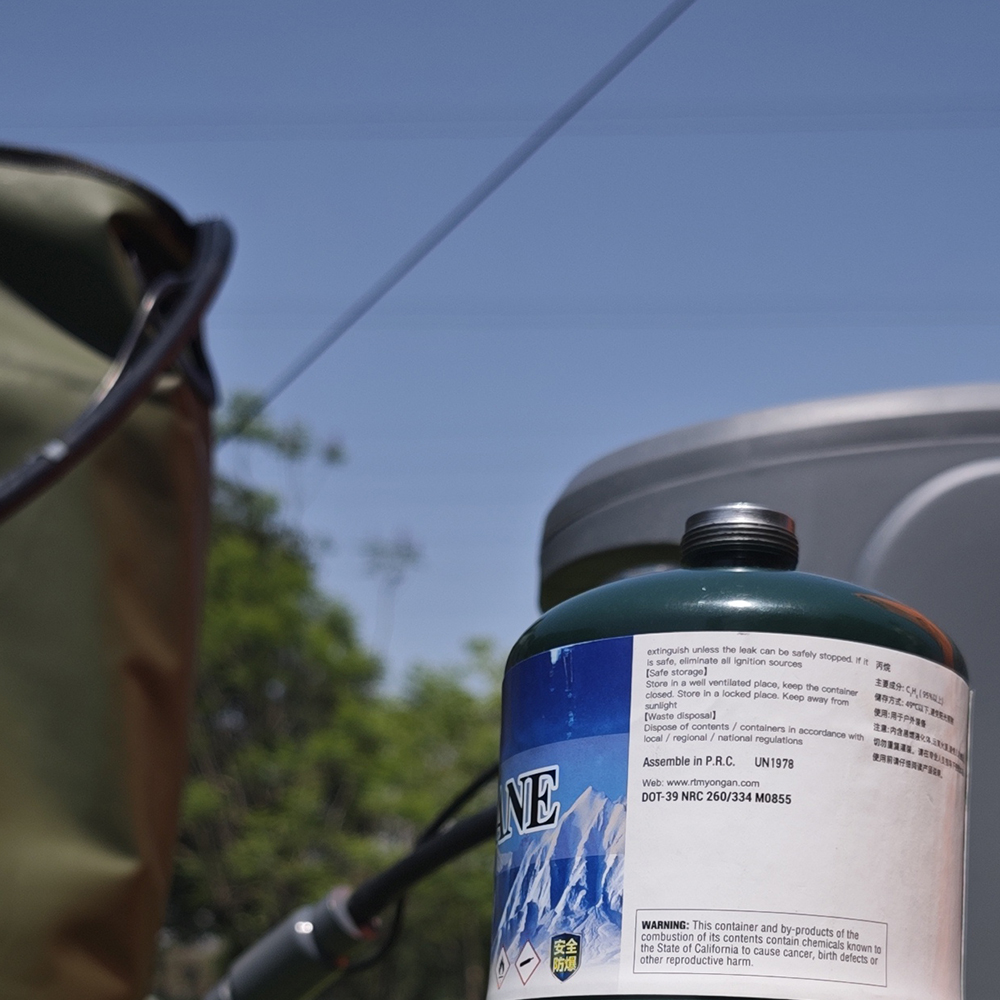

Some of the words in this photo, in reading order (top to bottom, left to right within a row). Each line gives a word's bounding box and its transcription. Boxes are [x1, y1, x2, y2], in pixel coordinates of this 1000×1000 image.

[647, 646, 689, 656] extinguish
[740, 646, 757, 654] leak
[792, 650, 817, 659] safely
[820, 653, 853, 663] stopped.
[656, 658, 676, 666] safe,
[679, 657, 718, 665] eliminate
[769, 660, 802, 668] sources
[646, 680, 668, 688] Store
[754, 681, 779, 689] place,
[783, 682, 803, 691] keep
[822, 686, 858, 696] container
[645, 702, 677, 710] sunlight
[646, 691, 674, 699] closed.
[723, 690, 751, 698] locked
[754, 691, 779, 699] place.
[783, 692, 804, 702] Keep
[807, 695, 828, 705] away
[831, 697, 849, 706] from
[644, 724, 677, 732] Dispose
[732, 722, 737, 731] /
[740, 724, 785, 733] containers
[799, 728, 846, 738] accordance
[848, 733, 864, 741] with
[666, 734, 670, 742] /
[673, 734, 707, 743] regional
[710, 733, 715, 741] /
[718, 734, 752, 742] national
[755, 736, 803, 745] regulations
[643, 756, 690, 767] Assemble
[694, 756, 702, 765] in
[706, 756, 735, 766] P.R.C.
[755, 757, 794, 769] UN1978
[667, 778, 760, 788] www.rtmyongan.com
[642, 792, 678, 802] DOT-39
[682, 791, 703, 801] NRC
[707, 791, 751, 802] 260/334
[755, 793, 791, 804] M0855
[642, 921, 689, 929] WARNING:
[693, 920, 712, 930] This
[715, 922, 758, 932] container
[761, 924, 778, 933] and
[781, 924, 833, 937] by-products
[836, 929, 845, 938] of
[847, 930, 859, 940] the
[554, 938, 578, 955] 安全
[641, 933, 694, 941] combustion
[697, 933, 706, 941] of
[709, 933, 720, 942] its
[723, 934, 763, 944] contents
[766, 936, 799, 946] contain
[802, 938, 844, 950] chemicals
[847, 942, 872, 953] known
[875, 945, 881, 954] to
[640, 956, 663, 964] other
[666, 956, 723, 966] reproductive
[727, 957, 753, 966] harm.
[641, 944, 654, 952] the
[657, 943, 680, 953] State
[683, 944, 692, 952] of
[695, 944, 738, 954] California
[742, 946, 750, 954] to
[754, 946, 780, 956] cause
[783, 949, 815, 960] cancer,
[818, 951, 837, 960] birth
[840, 952, 868, 964] defects
[870, 957, 878, 965] or
